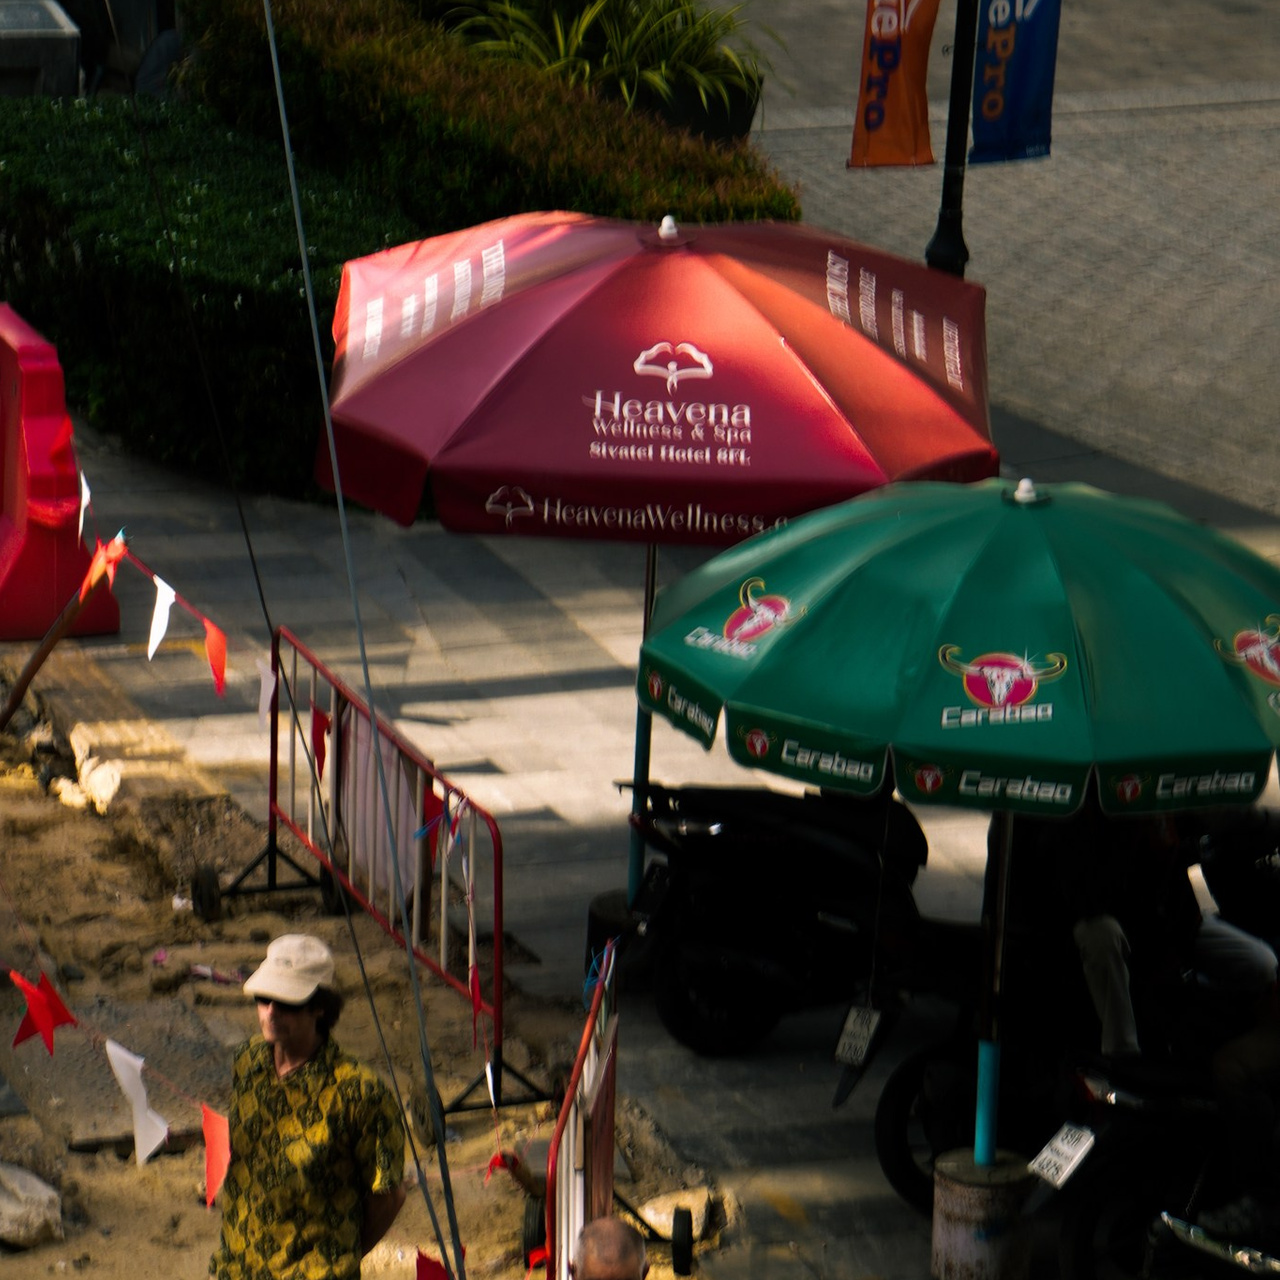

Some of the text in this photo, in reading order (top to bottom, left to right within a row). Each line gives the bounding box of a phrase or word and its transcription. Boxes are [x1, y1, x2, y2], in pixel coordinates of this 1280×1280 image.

[584, 390, 751, 428] Heavena
[592, 417, 752, 447] Wellness & Spa
[589, 440, 655, 462] Sivatel
[660, 443, 712, 465] Hotel
